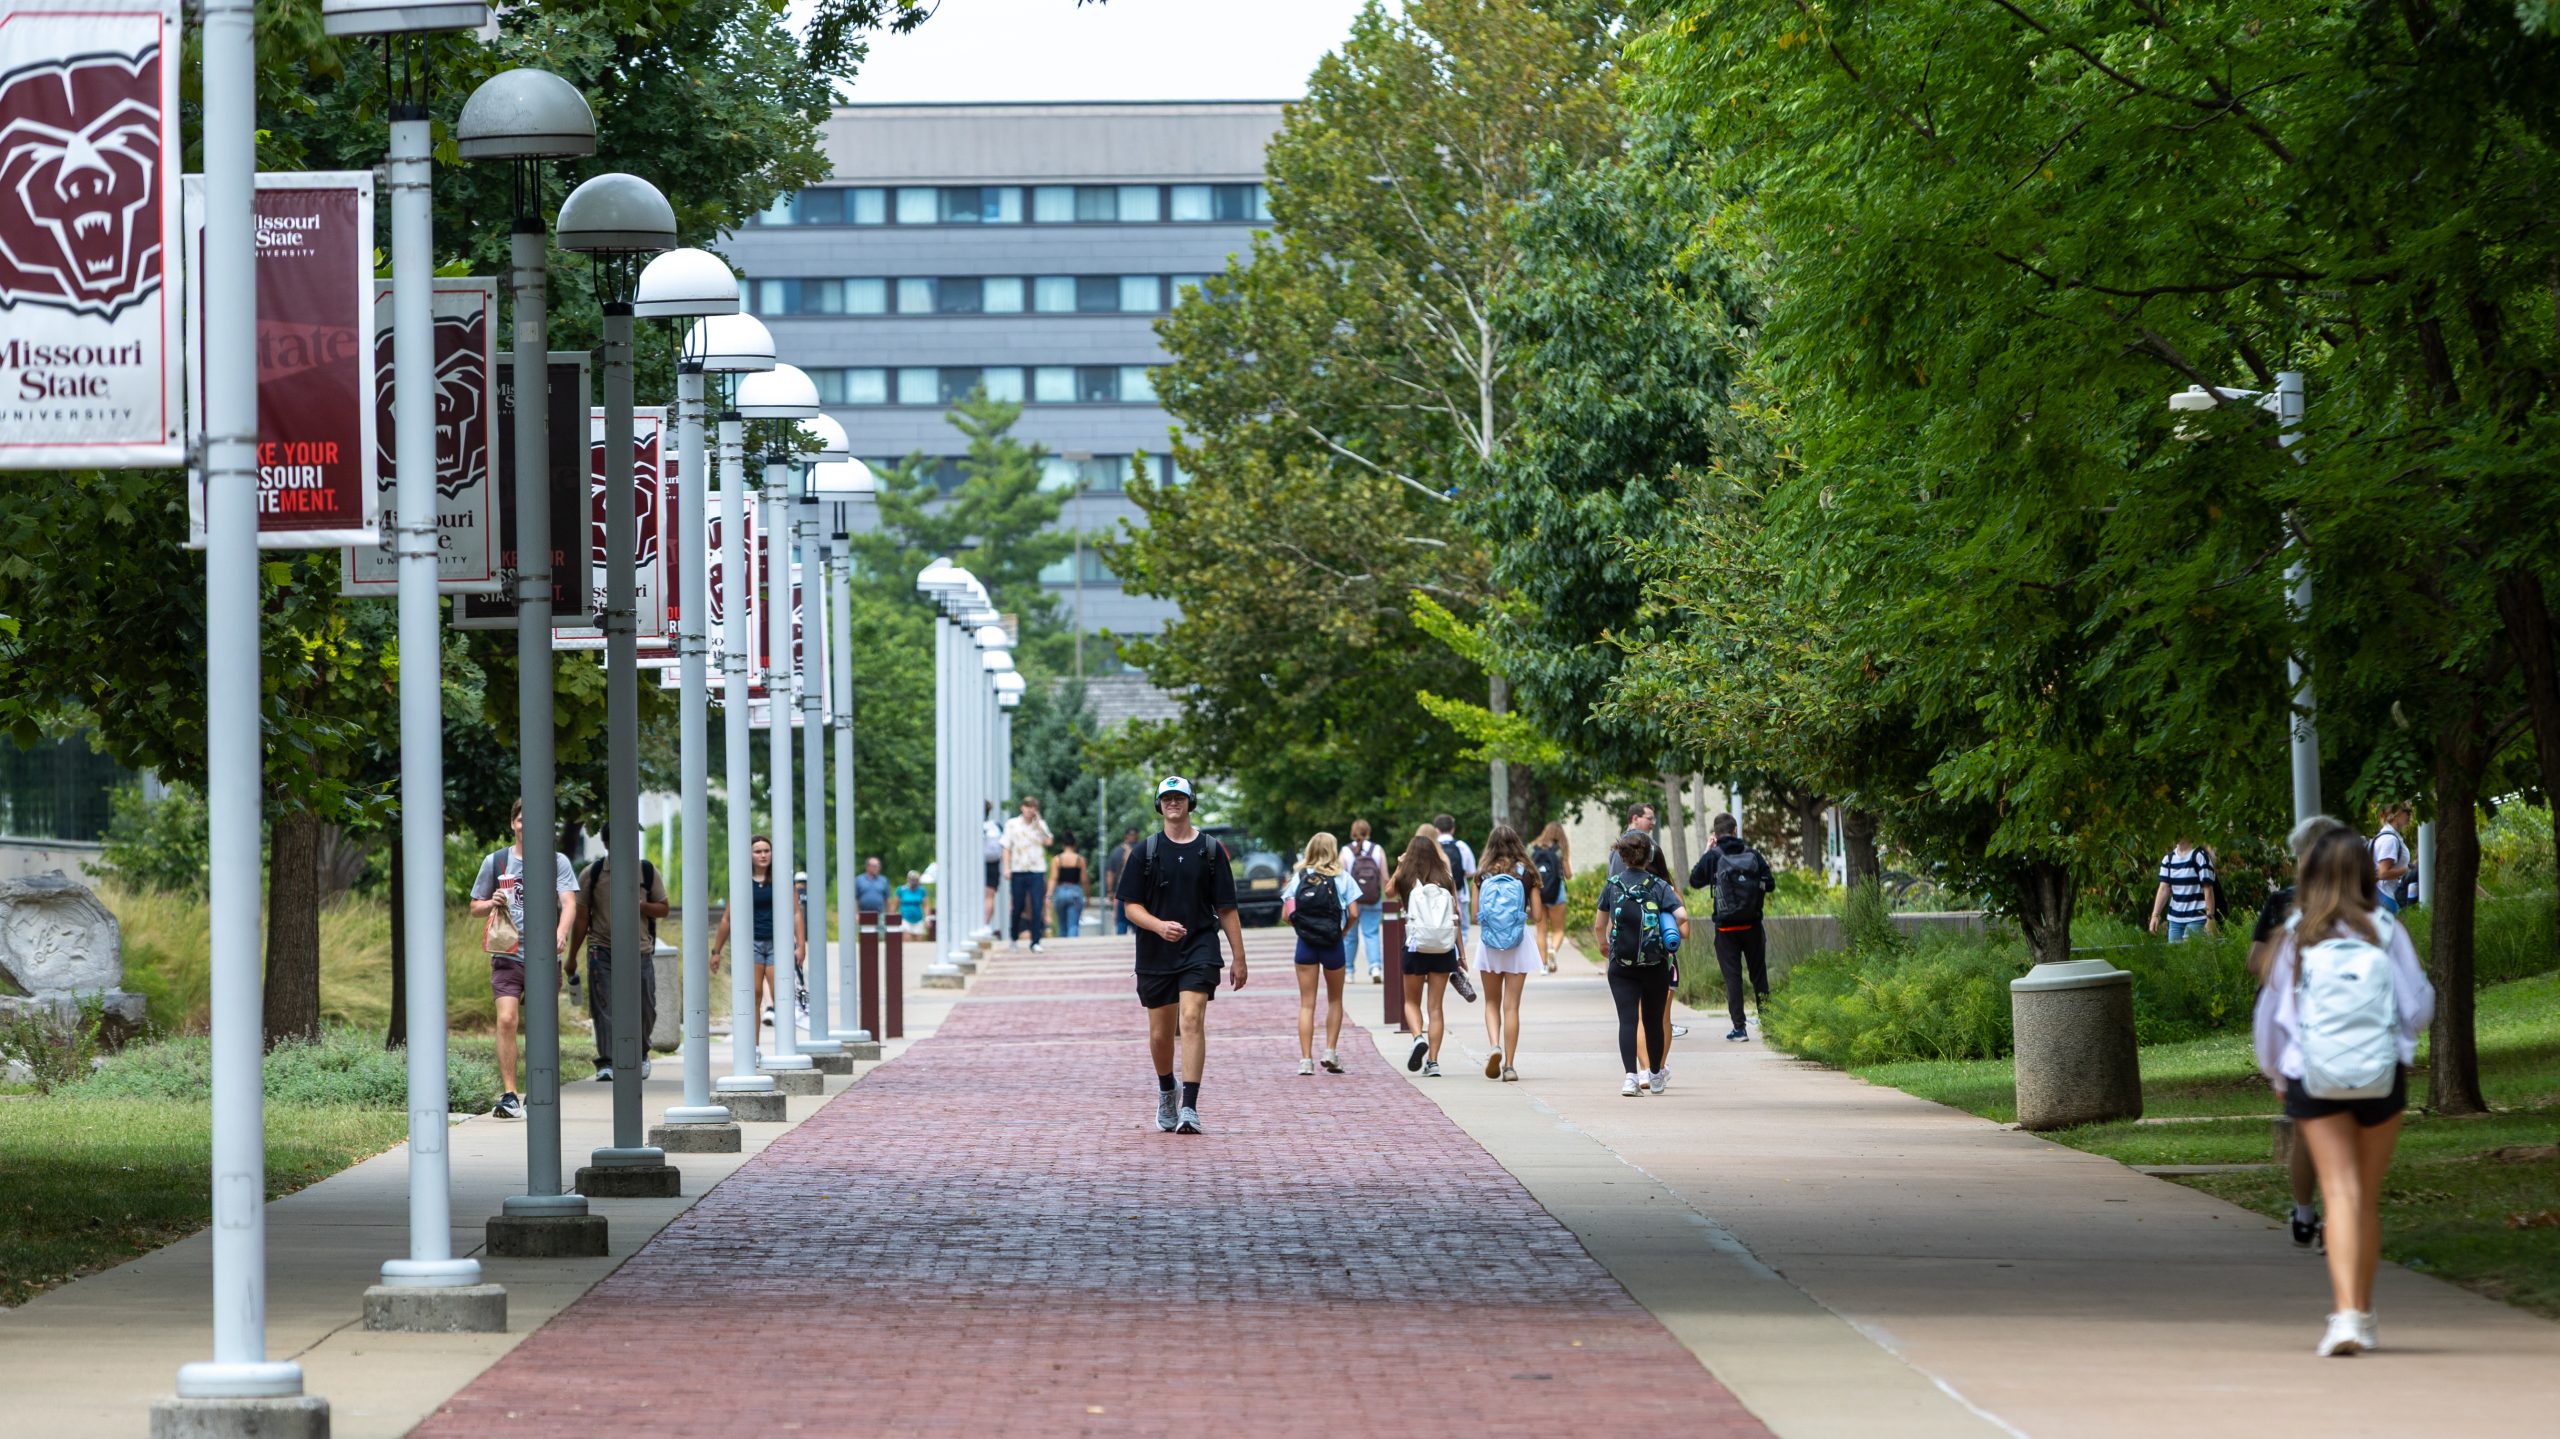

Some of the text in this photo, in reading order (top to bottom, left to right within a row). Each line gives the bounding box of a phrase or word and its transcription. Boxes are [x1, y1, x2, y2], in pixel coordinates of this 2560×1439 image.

[254, 214, 320, 230] issouri
[255, 229, 303, 248] State
[255, 249, 315, 257] IVERSITY
[256, 327, 358, 369] tate
[18, 368, 110, 402] State
[256, 442, 339, 466] KE YOUR
[256, 465, 323, 490] SOURI
[256, 489, 339, 513] TEMENT.
